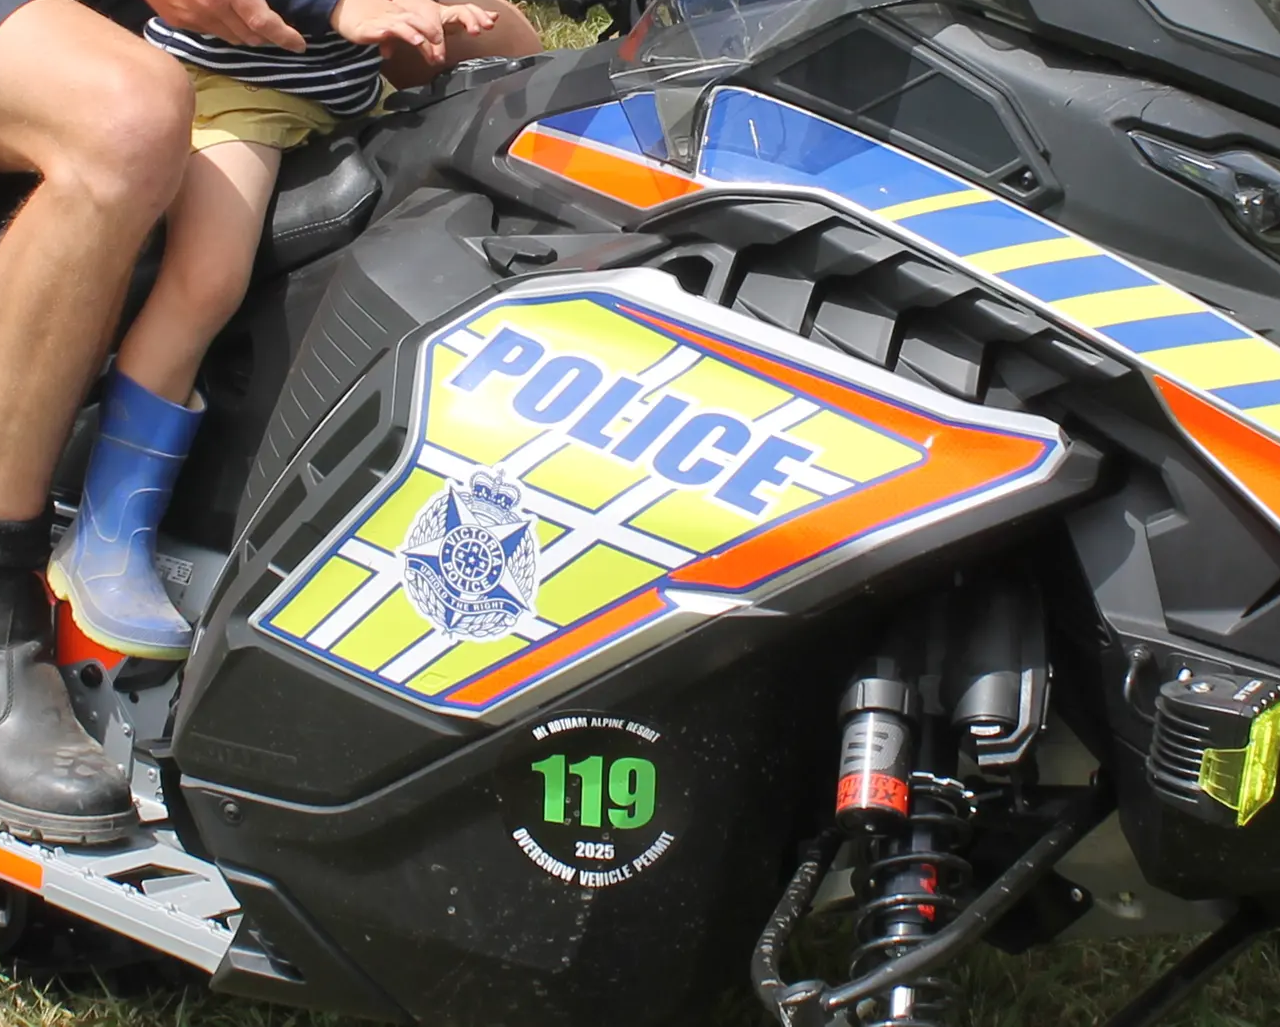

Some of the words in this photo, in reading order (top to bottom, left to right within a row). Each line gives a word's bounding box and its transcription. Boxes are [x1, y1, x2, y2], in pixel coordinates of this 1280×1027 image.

[451, 327, 814, 516] POLICE
[446, 526, 503, 567] VICTORIA
[420, 565, 448, 600] UPHOLD
[450, 599, 470, 611] THE
[473, 600, 506, 612] RIGHT
[443, 561, 491, 593] POLICE
[547, 716, 588, 732] HOTHAM
[590, 717, 625, 730] ALPINE
[625, 721, 661, 743] RESORT
[531, 754, 657, 830] 119
[512, 827, 577, 882] OVERSNOW
[579, 864, 633, 887] VEHICLE
[632, 830, 675, 872] PERMIT
[575, 841, 615, 860] 2025
